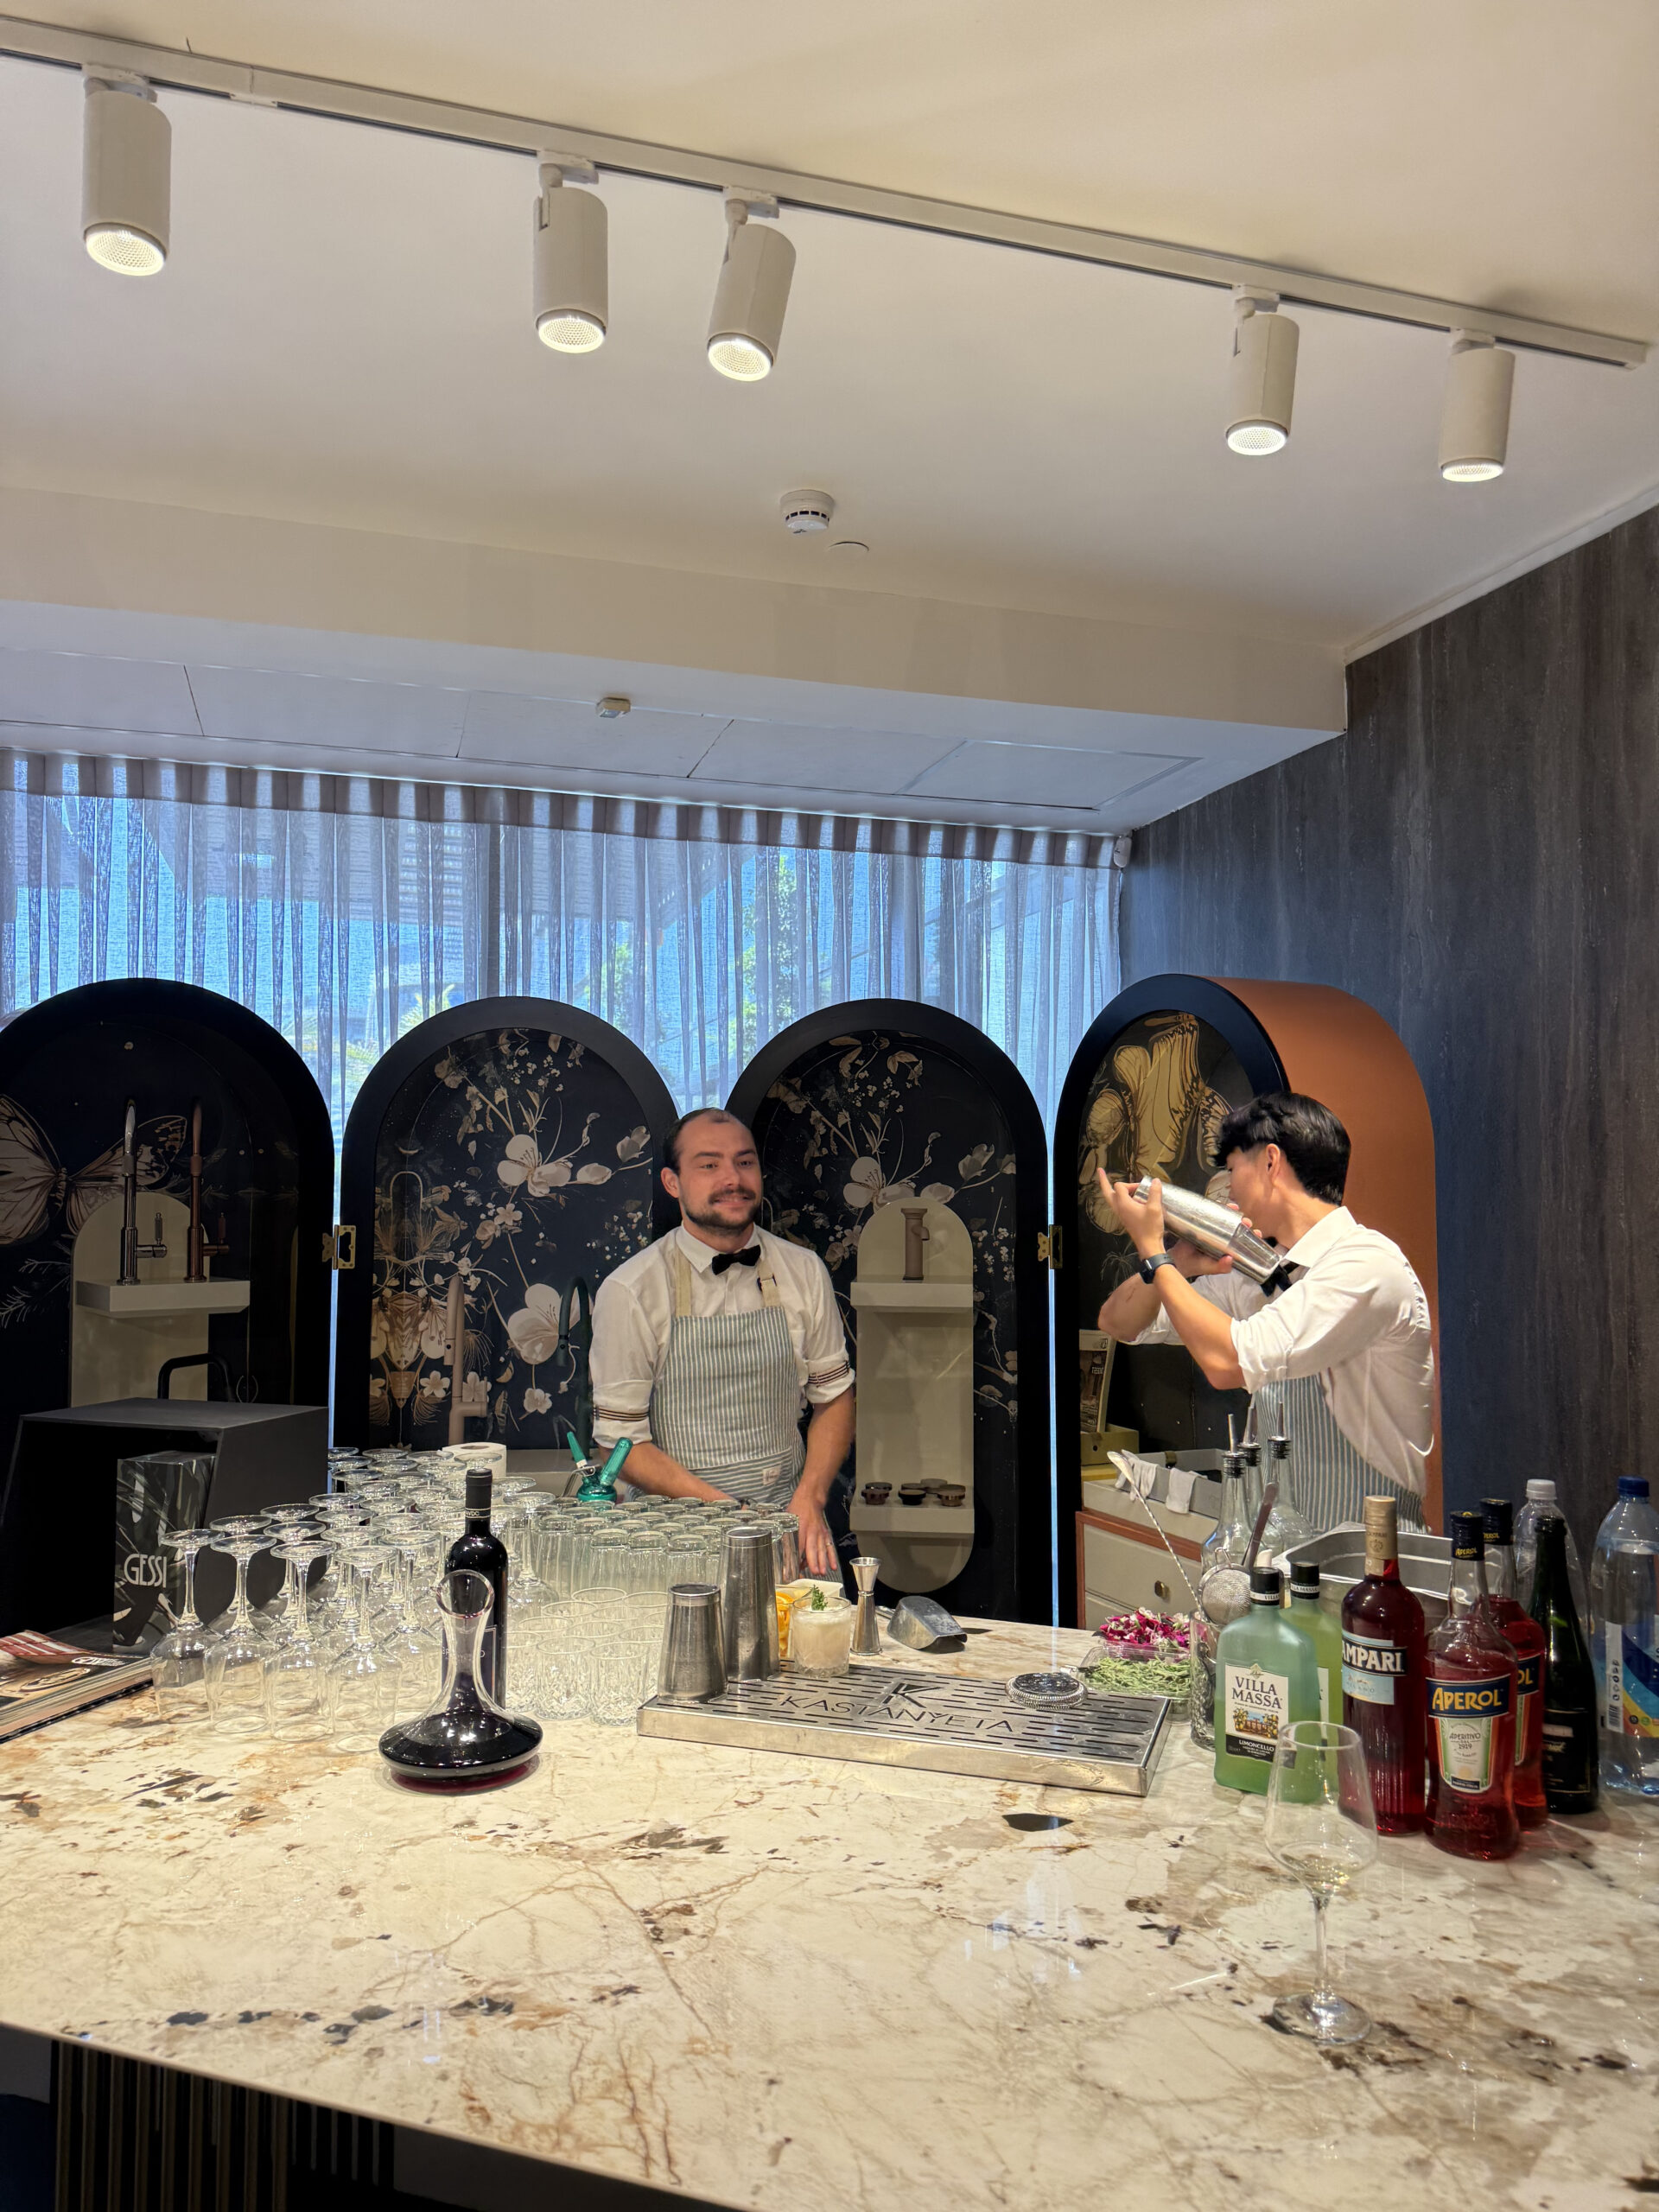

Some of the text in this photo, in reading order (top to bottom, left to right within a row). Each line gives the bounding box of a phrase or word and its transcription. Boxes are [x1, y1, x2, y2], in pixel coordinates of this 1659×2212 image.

[124, 1553, 167, 1588] GESSI
[1342, 1639, 1402, 1673] AMPARI
[1235, 1676, 1278, 1696] VILLA
[1232, 1688, 1282, 1710] MASSA
[1432, 1687, 1502, 1711] APEROL
[779, 1695, 1013, 1732] KASTANYETA
[1238, 1739, 1274, 1752] LIMONCELLO
